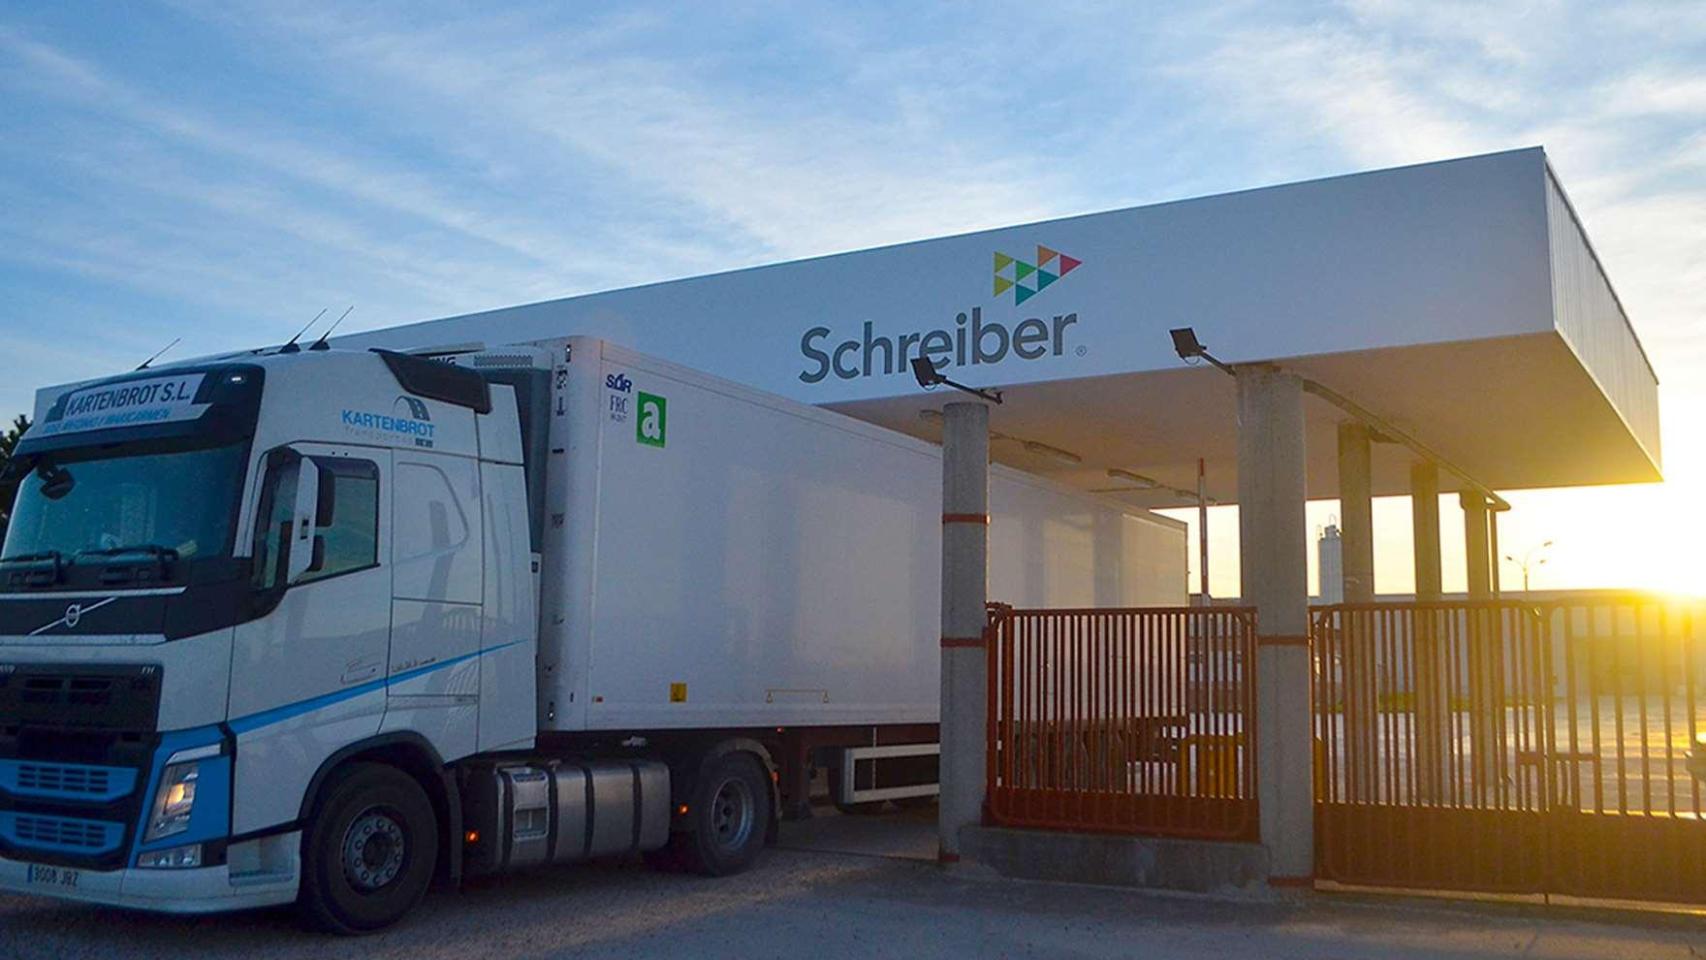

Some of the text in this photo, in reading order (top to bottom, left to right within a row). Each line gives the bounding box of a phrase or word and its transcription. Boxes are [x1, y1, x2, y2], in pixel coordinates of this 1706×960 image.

[799, 307, 1077, 383] Schreiber
[66, 381, 190, 416] KARTENBROT S.L.
[610, 395, 628, 414] FRC
[342, 409, 434, 437] KARTENBROT
